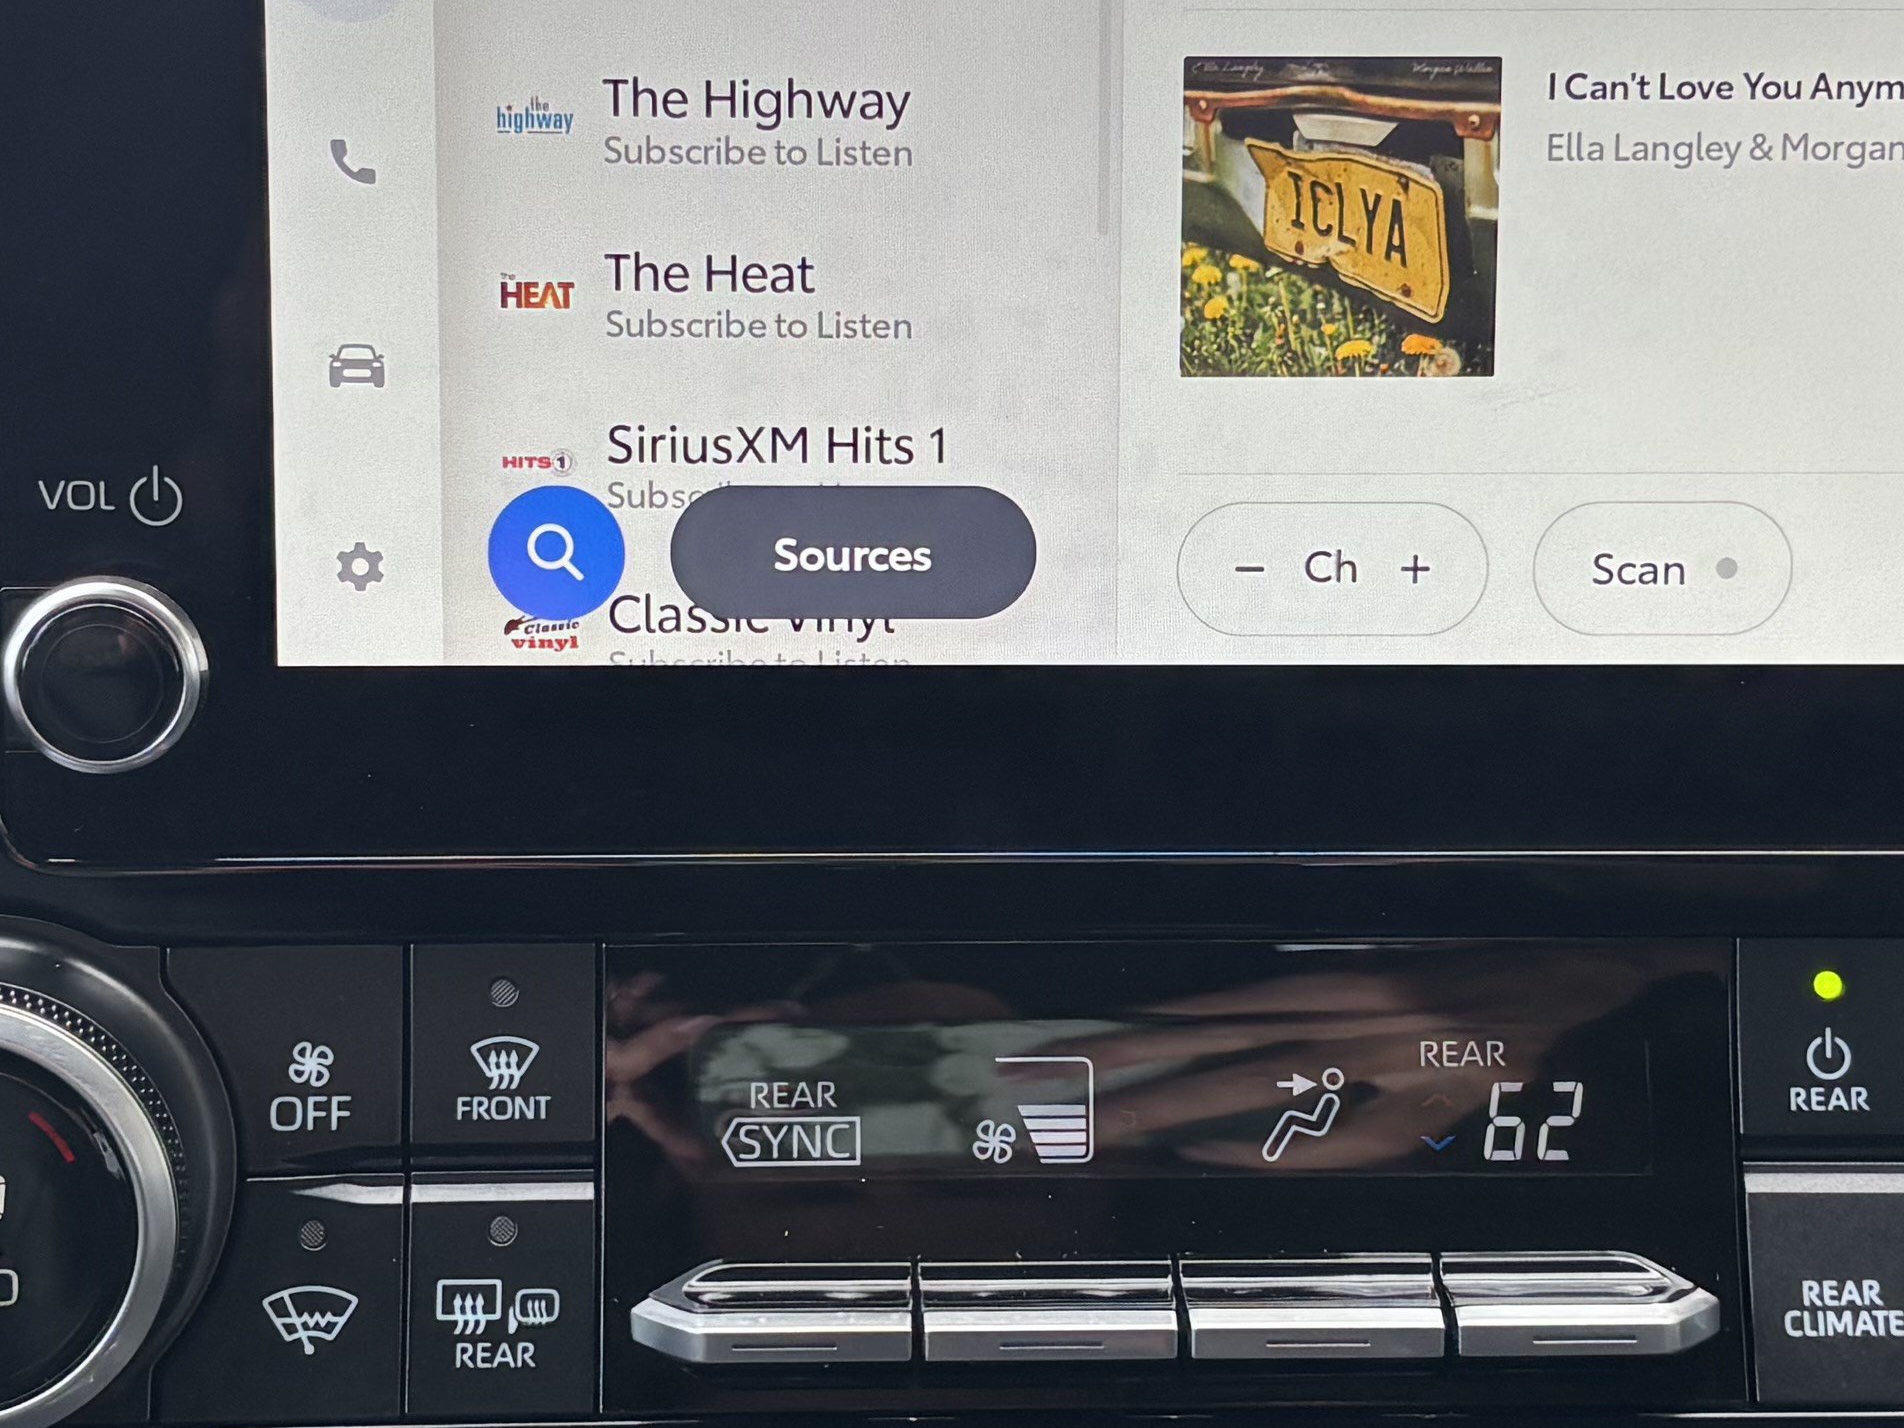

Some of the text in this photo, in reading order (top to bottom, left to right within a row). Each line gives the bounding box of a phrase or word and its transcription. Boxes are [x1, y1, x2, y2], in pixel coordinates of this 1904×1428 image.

[1548, 73, 1556, 102] I
[1564, 72, 1652, 103] Can't
[1659, 73, 1735, 103] Love
[1744, 73, 1805, 103] You
[496, 105, 574, 134] highway
[602, 78, 912, 130] The Highway
[604, 136, 914, 168] Subscribe to Listen
[1548, 131, 1605, 164] Ella
[1613, 132, 1742, 172] Langley
[1749, 134, 1776, 164] &
[1287, 169, 1409, 269] ICLYA
[604, 252, 816, 294] The Heat
[500, 281, 575, 310] HEAT
[605, 309, 914, 341] Subscribe to Listen
[607, 424, 948, 466] SiriusXM Hits 1
[502, 456, 552, 469] HITS
[38, 480, 115, 511] VOL
[774, 536, 932, 572] Sources
[1304, 549, 1358, 585] Ch
[1592, 553, 1686, 587] Scan
[511, 635, 579, 652] vinyl
[1419, 1040, 1506, 1068] REAR
[456, 1094, 552, 1123] FRONT
[749, 1081, 837, 1109] REAR
[1789, 1086, 1870, 1113] REAR
[268, 1095, 352, 1133] OFF
[1482, 1081, 1584, 1162] 62
[737, 1122, 851, 1160] SYNC
[1802, 1279, 1884, 1308] REAR
[455, 1342, 536, 1370] REAR
